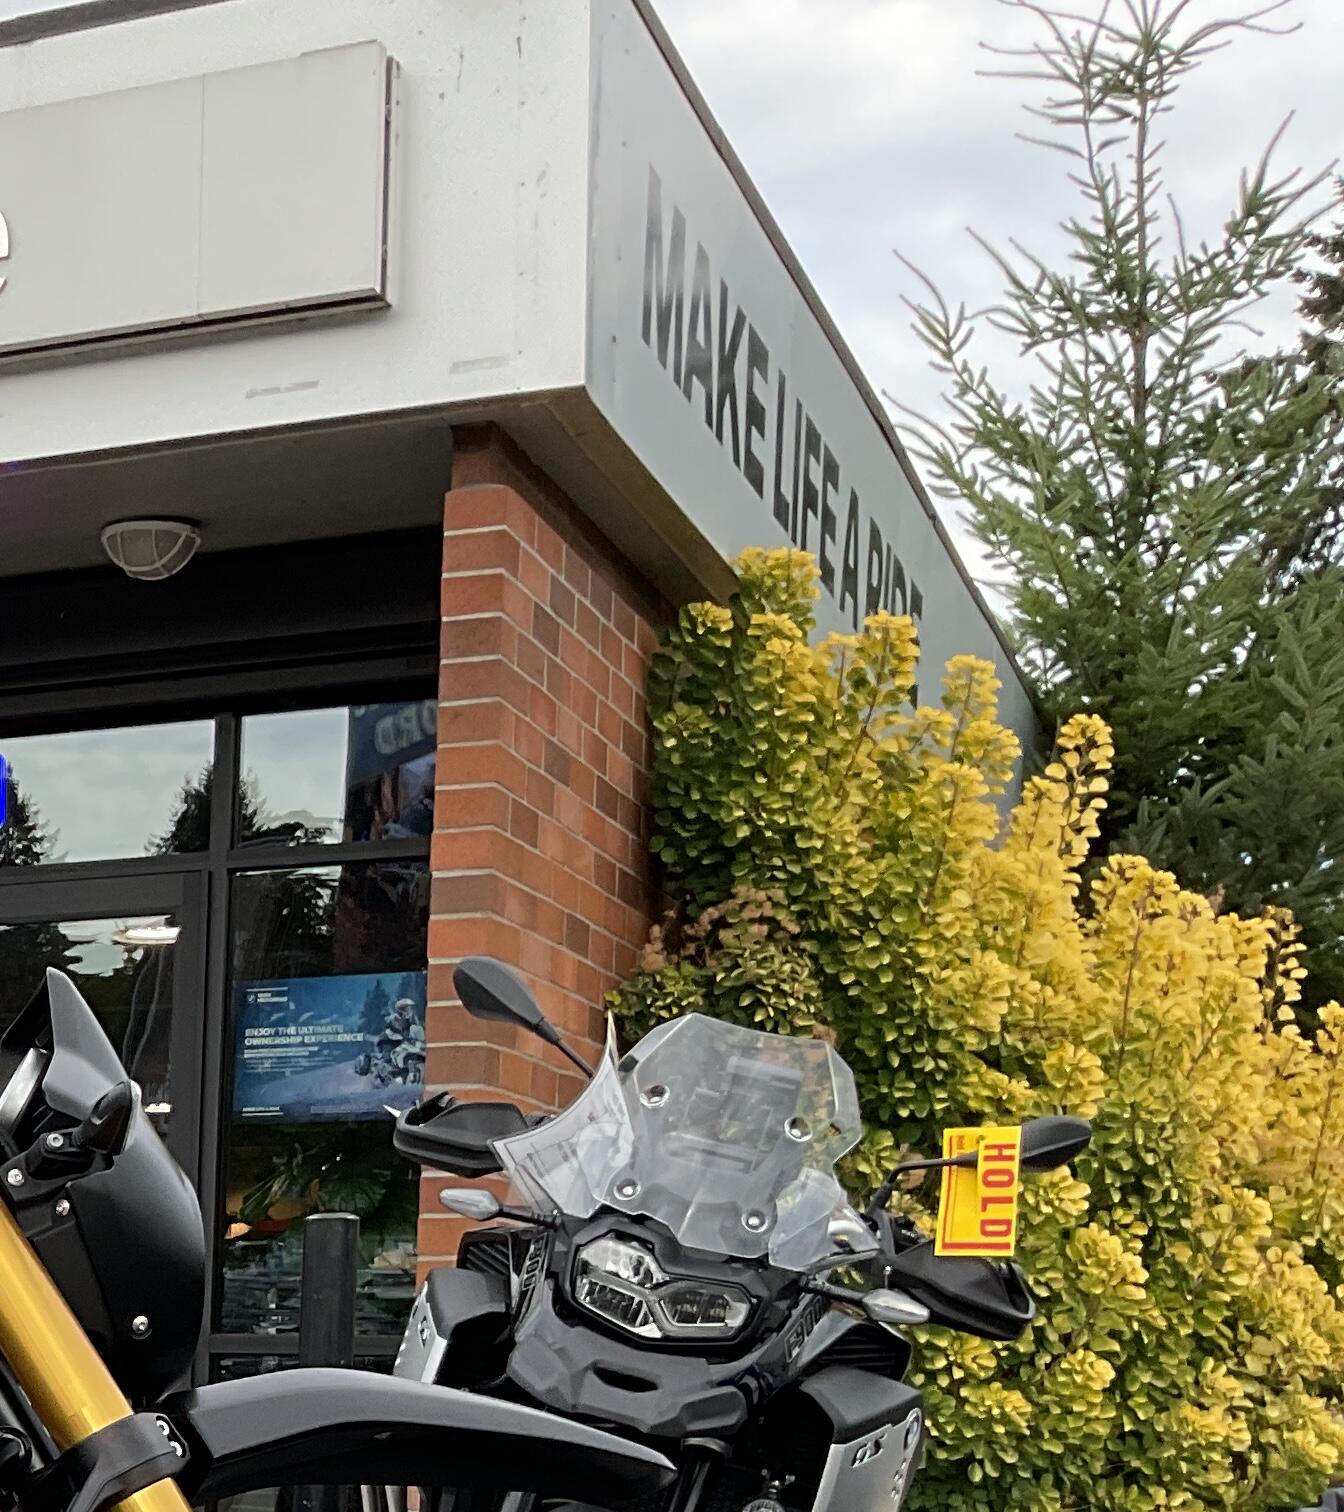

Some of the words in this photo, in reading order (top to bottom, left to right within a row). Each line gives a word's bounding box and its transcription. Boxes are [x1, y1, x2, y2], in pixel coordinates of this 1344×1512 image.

[641, 161, 770, 500] MAKE
[773, 367, 840, 599] LIFE
[840, 486, 859, 632] A
[278, 1025, 297, 1036] THE
[979, 1143, 1017, 1238] HOLD
